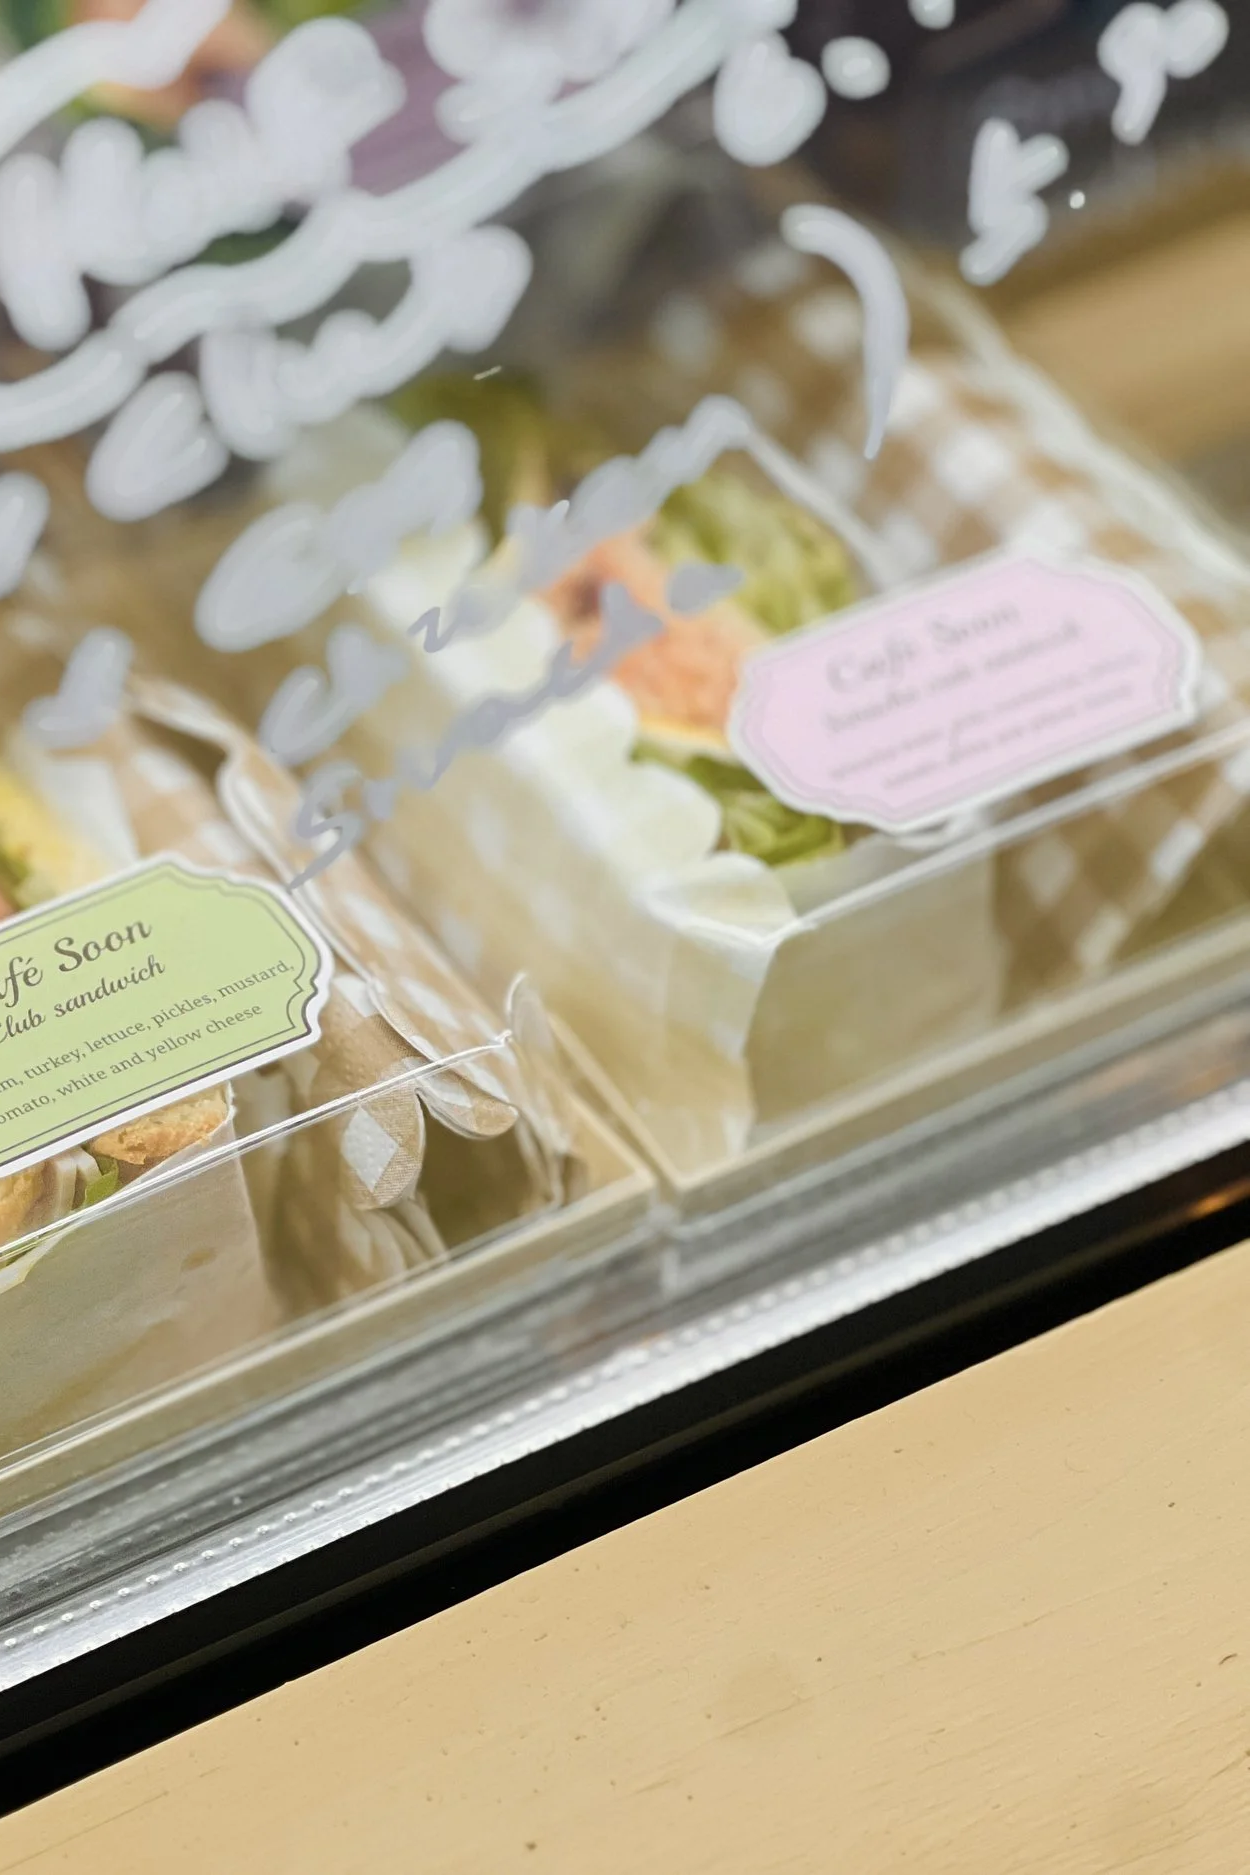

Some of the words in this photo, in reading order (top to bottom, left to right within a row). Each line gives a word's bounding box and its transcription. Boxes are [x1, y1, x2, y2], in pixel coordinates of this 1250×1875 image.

[54, 920, 152, 972] Soon
[23, 1048, 86, 1079] turkey,
[84, 1020, 151, 1053] lettuce,
[151, 991, 218, 1028] pickles,
[218, 960, 295, 999] mustard,
[54, 955, 165, 1017] sandwich
[56, 1068, 108, 1097] white
[109, 1051, 145, 1075] and
[145, 1029, 203, 1062] yellow
[205, 1004, 264, 1034] cheese
